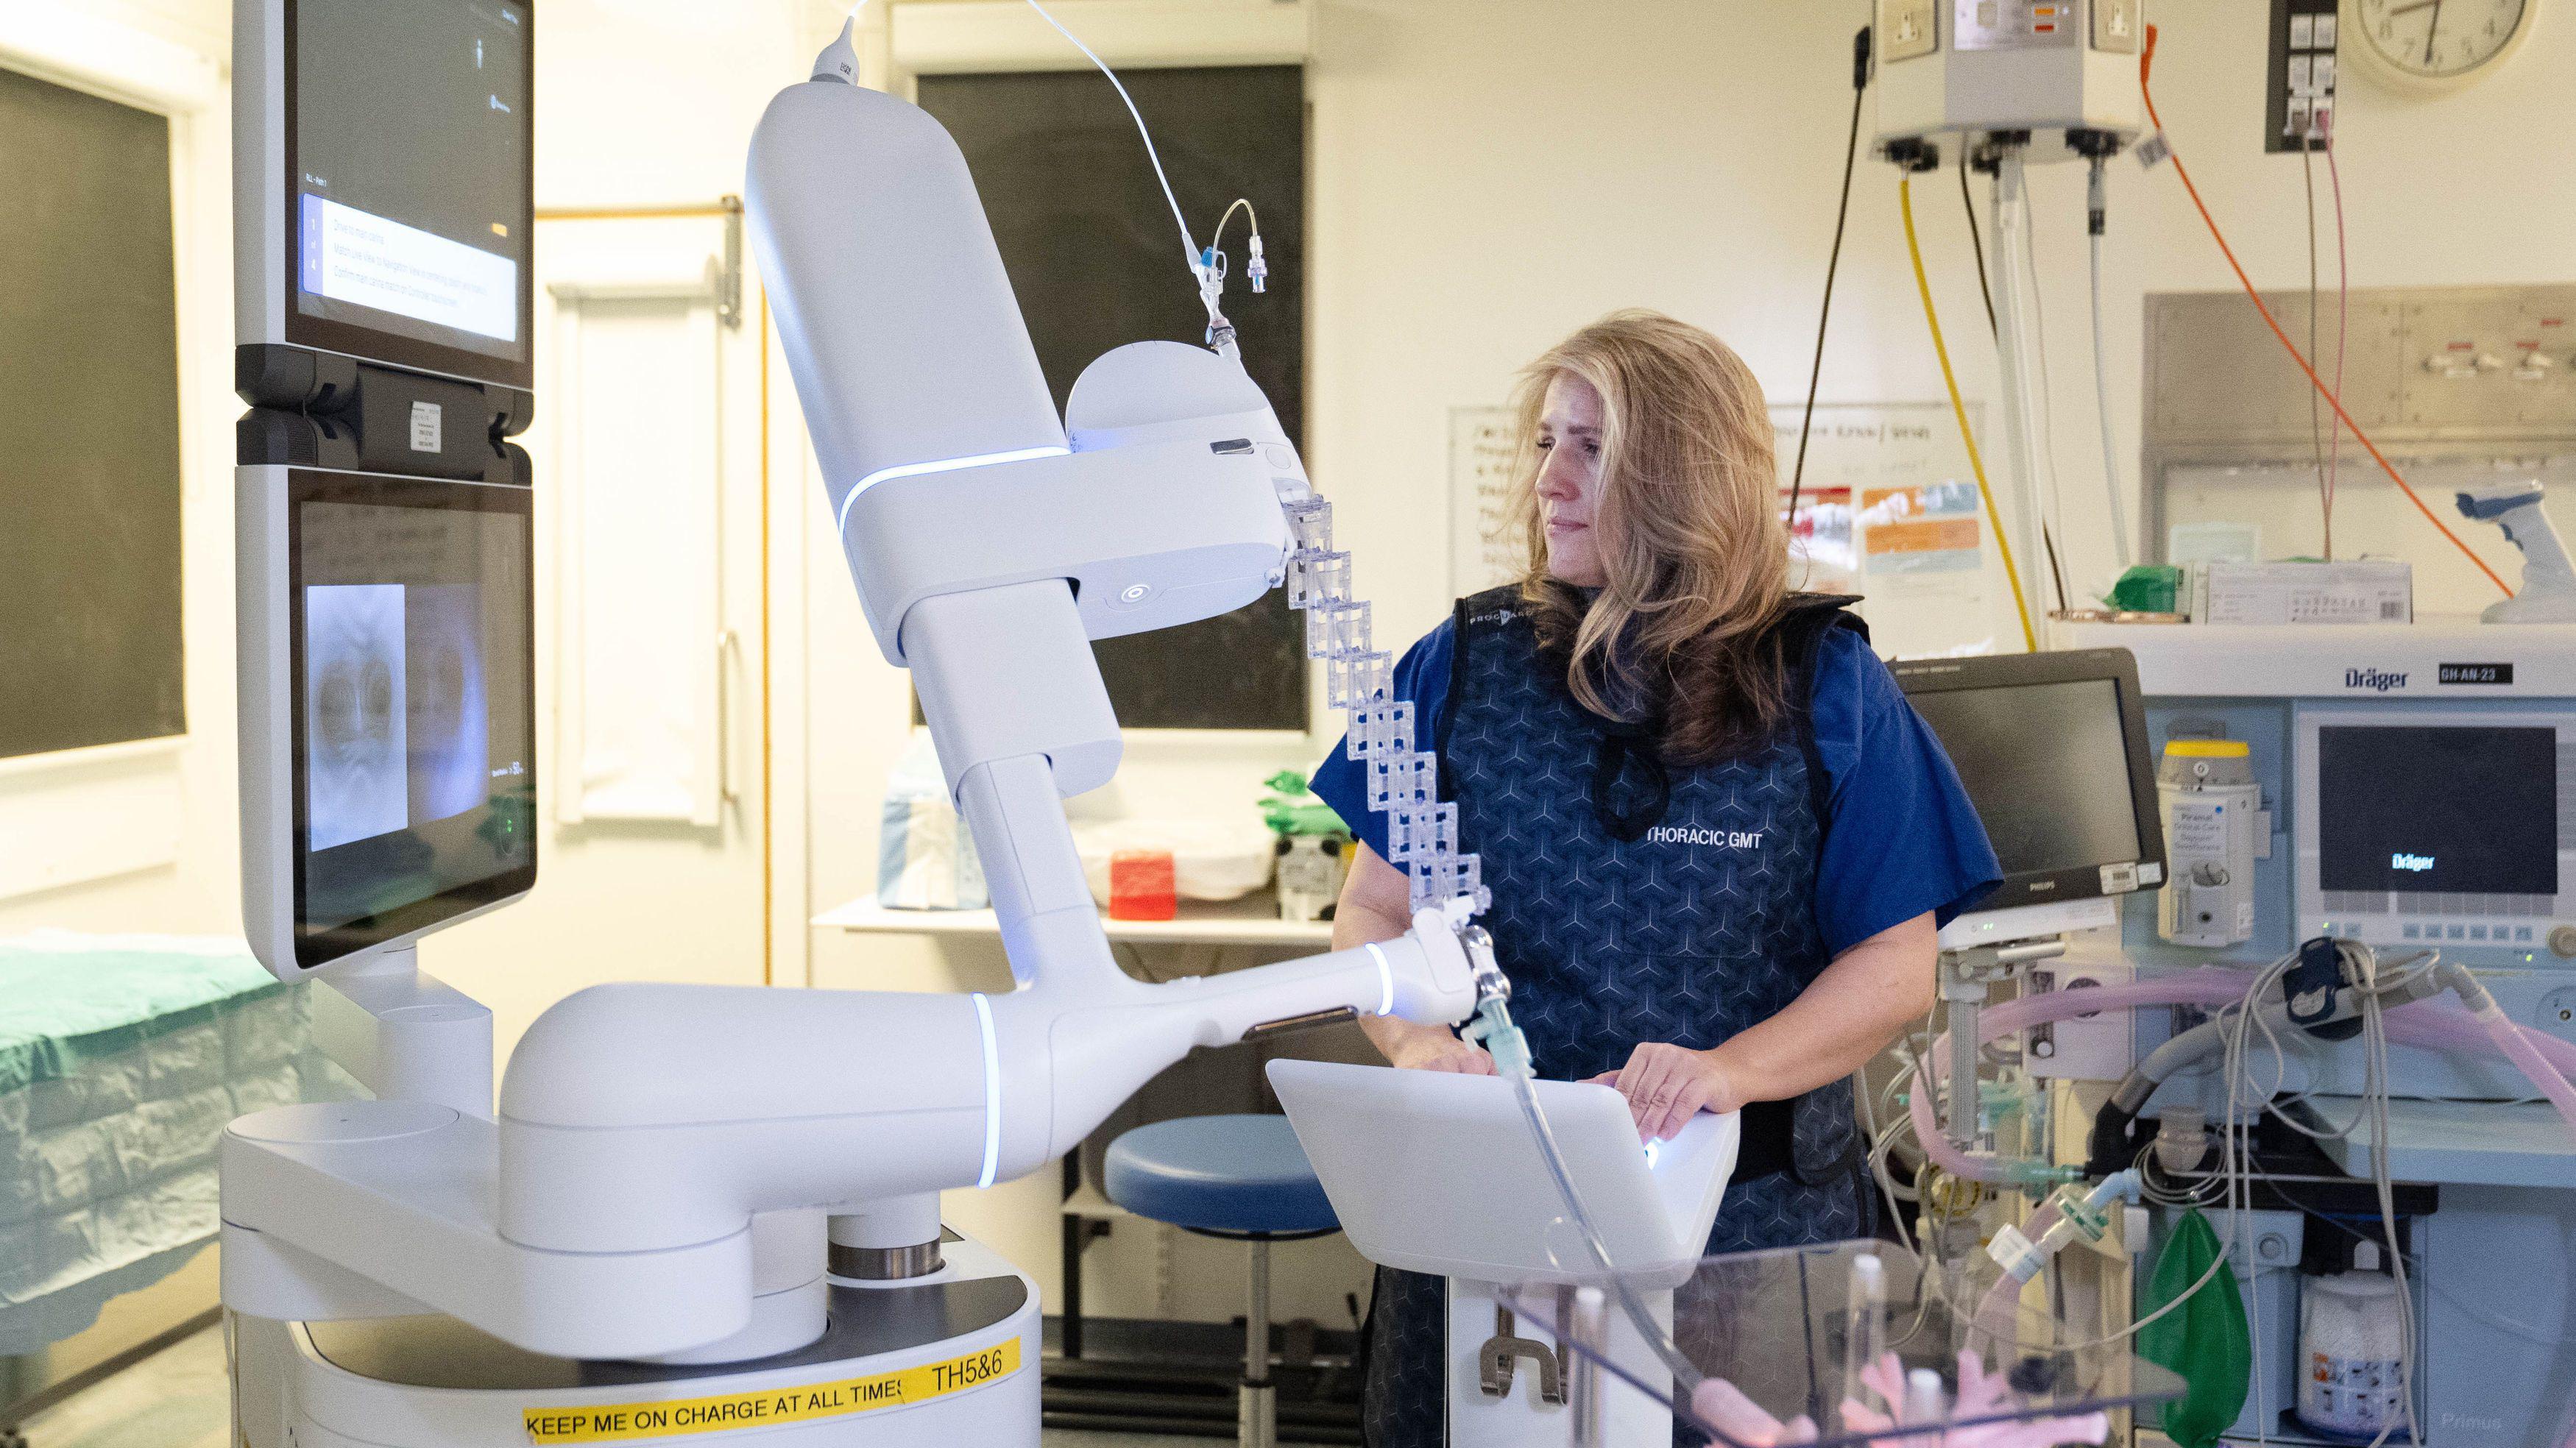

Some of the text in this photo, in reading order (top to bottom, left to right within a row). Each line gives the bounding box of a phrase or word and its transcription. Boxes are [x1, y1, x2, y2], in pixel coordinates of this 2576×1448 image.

[2403, 38, 2416, 60] 7
[311, 219, 316, 230] 1
[311, 258, 316, 272] 4
[2346, 667, 2409, 692] Dräger
[1647, 827, 1763, 848] THORACIC GMT
[2392, 853, 2435, 872] Dräger
[932, 1349, 1002, 1391] TH5&6
[526, 1416, 586, 1435] KEEP
[594, 1413, 628, 1433] ME
[634, 1410, 668, 1429] ON
[675, 1399, 768, 1426] CHARGE
[774, 1394, 802, 1415] AT
[808, 1390, 844, 1410] ALL
